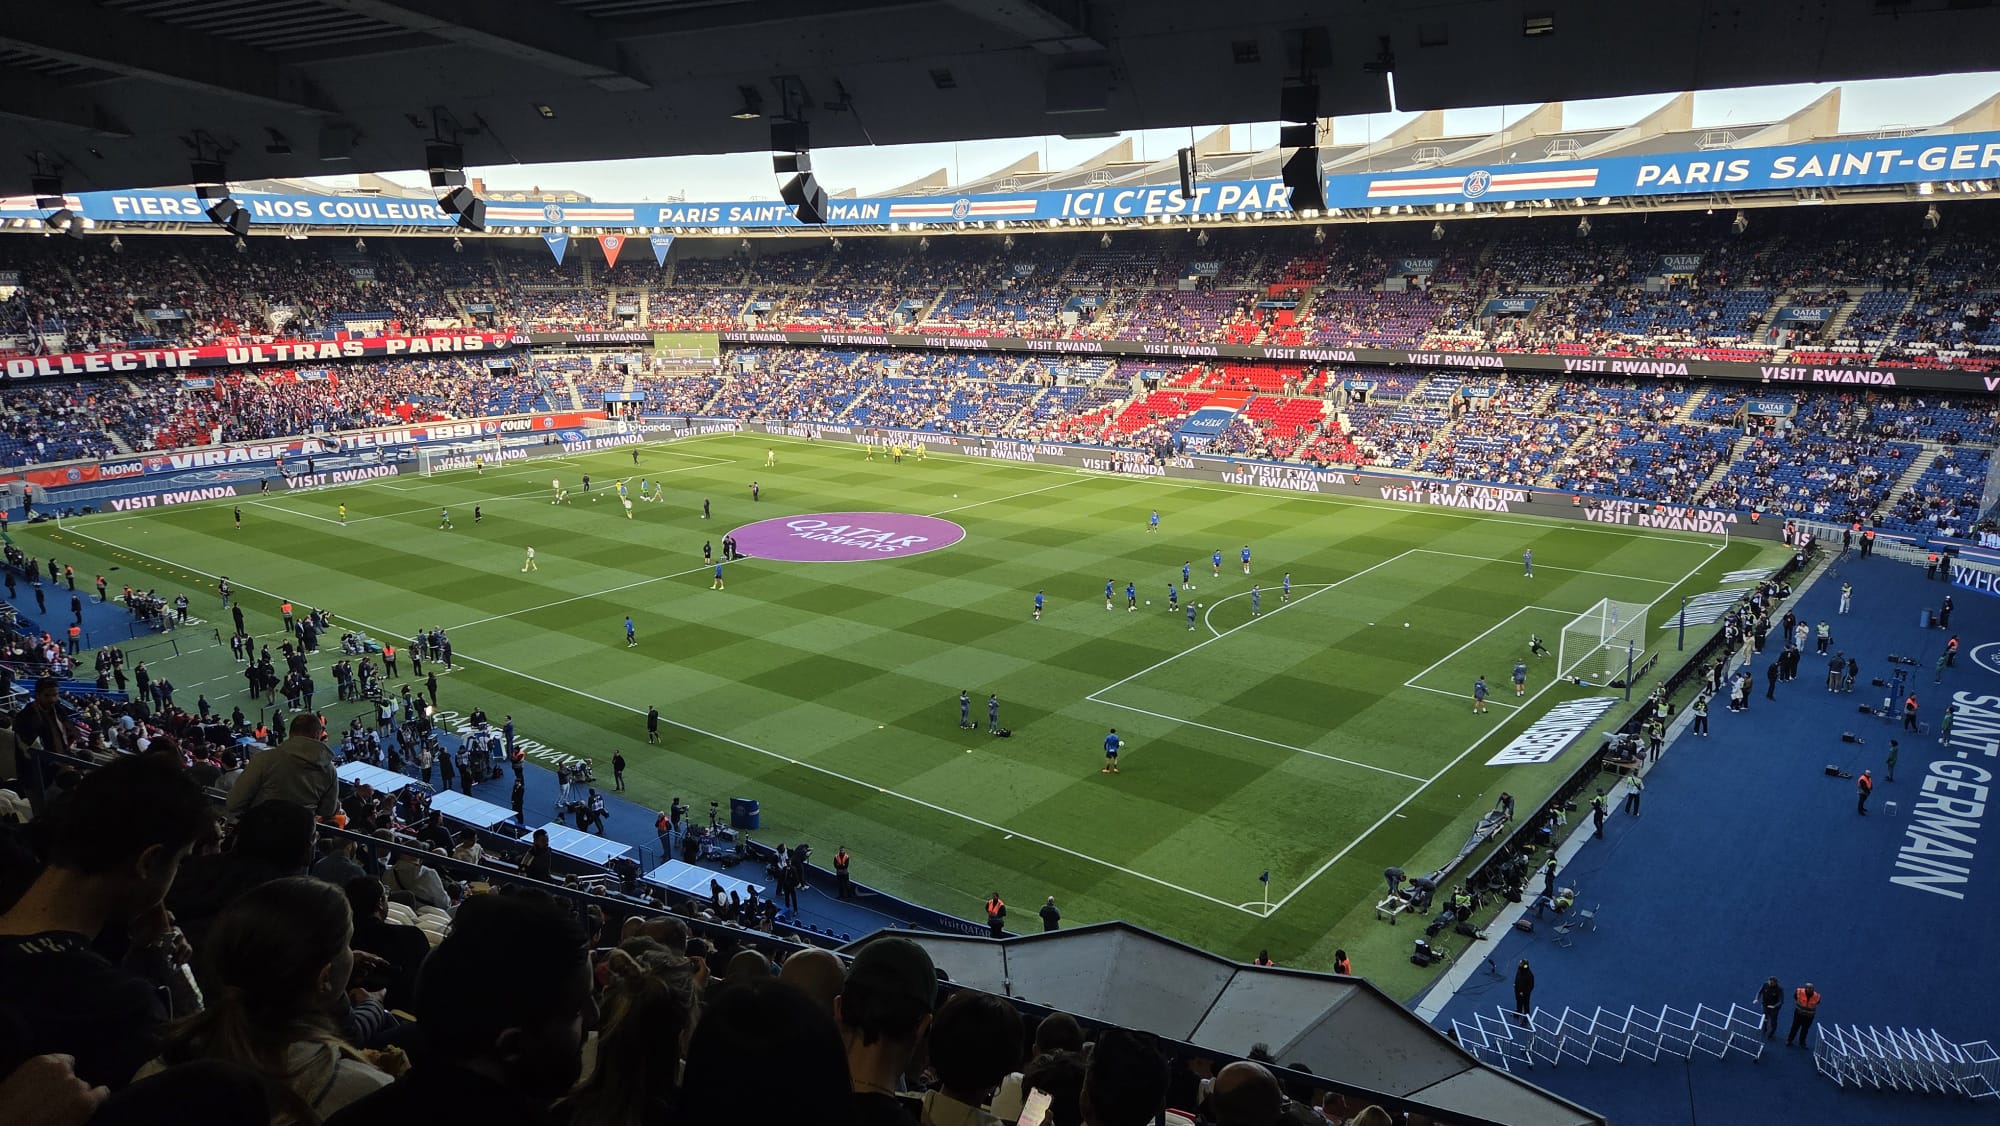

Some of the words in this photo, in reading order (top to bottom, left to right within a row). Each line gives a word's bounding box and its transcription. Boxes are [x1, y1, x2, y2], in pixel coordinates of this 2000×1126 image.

[1636, 159, 1751, 187] PARIS
[112, 196, 200, 216] FIERS
[255, 199, 314, 218] NOS
[1062, 192, 1105, 216] ICI
[1113, 187, 1211, 215] C'EST
[658, 207, 721, 223] PARIS
[1194, 262, 1219, 271] QATAR
[1404, 259, 1433, 268] QATAR
[1664, 256, 1700, 266] QATAR
[574, 333, 601, 342] VISIT
[603, 332, 648, 341] RWANDA
[725, 332, 748, 341] VISIT
[750, 333, 787, 342] RWANDA
[820, 334, 845, 344] VISIT
[847, 335, 889, 345] RWANDA
[924, 337, 947, 346] VISIT
[949, 338, 988, 347] RWANDA
[1026, 340, 1053, 350] VISIT
[1055, 341, 1102, 352] RWANDA
[1143, 344, 1170, 354] VISIT
[1172, 345, 1218, 356] RWANDA
[0, 350, 200, 379] OLLECTIF
[226, 340, 364, 364] ULTRAS
[386, 336, 484, 355] PARIS
[1263, 348, 1296, 359] VISIT
[1299, 350, 1356, 361] RWANDA
[1408, 353, 1441, 365] VISIT
[1444, 355, 1504, 367] RWANDA
[1564, 359, 1606, 372] VISIT
[1611, 360, 1689, 375] RWANDA
[1761, 366, 1807, 380] VISIT
[1812, 369, 1896, 386] RWANDA
[500, 418, 532, 432] COULY
[626, 421, 671, 433] bitpanda
[674, 426, 699, 438] VISIT
[765, 425, 785, 435] VISIT
[562, 439, 592, 452] VISIT
[596, 434, 644, 449] RWANDA
[855, 434, 879, 445] VISIT
[888, 430, 910, 439] VISIT
[912, 432, 951, 444] RWANDA
[169, 443, 290, 470] VIRAGE
[301, 431, 416, 455] ATEUIL
[425, 422, 482, 440] 1991
[992, 440, 1018, 450] VISIT
[1020, 443, 1063, 456] RWANDA
[963, 445, 988, 455] VISIT
[991, 447, 1035, 462] RWANDA
[102, 462, 143, 477] MOMO
[1082, 458, 1110, 470] VISIT
[285, 473, 328, 489] VISIT
[332, 464, 399, 483] RWANDA
[1250, 465, 1282, 479] VISIT
[1221, 471, 1256, 485] VISIT
[1259, 475, 1319, 492] RWANDA
[111, 495, 157, 512] VISIT
[163, 485, 237, 505] RWANDA
[1380, 487, 1424, 502] VISIT
[1430, 492, 1510, 513] RWANDA
[1583, 508, 1632, 524] VISIT
[1638, 513, 1726, 534] RWANDA
[786, 519, 929, 547] QATAR
[789, 531, 904, 552] AIRWAYS
